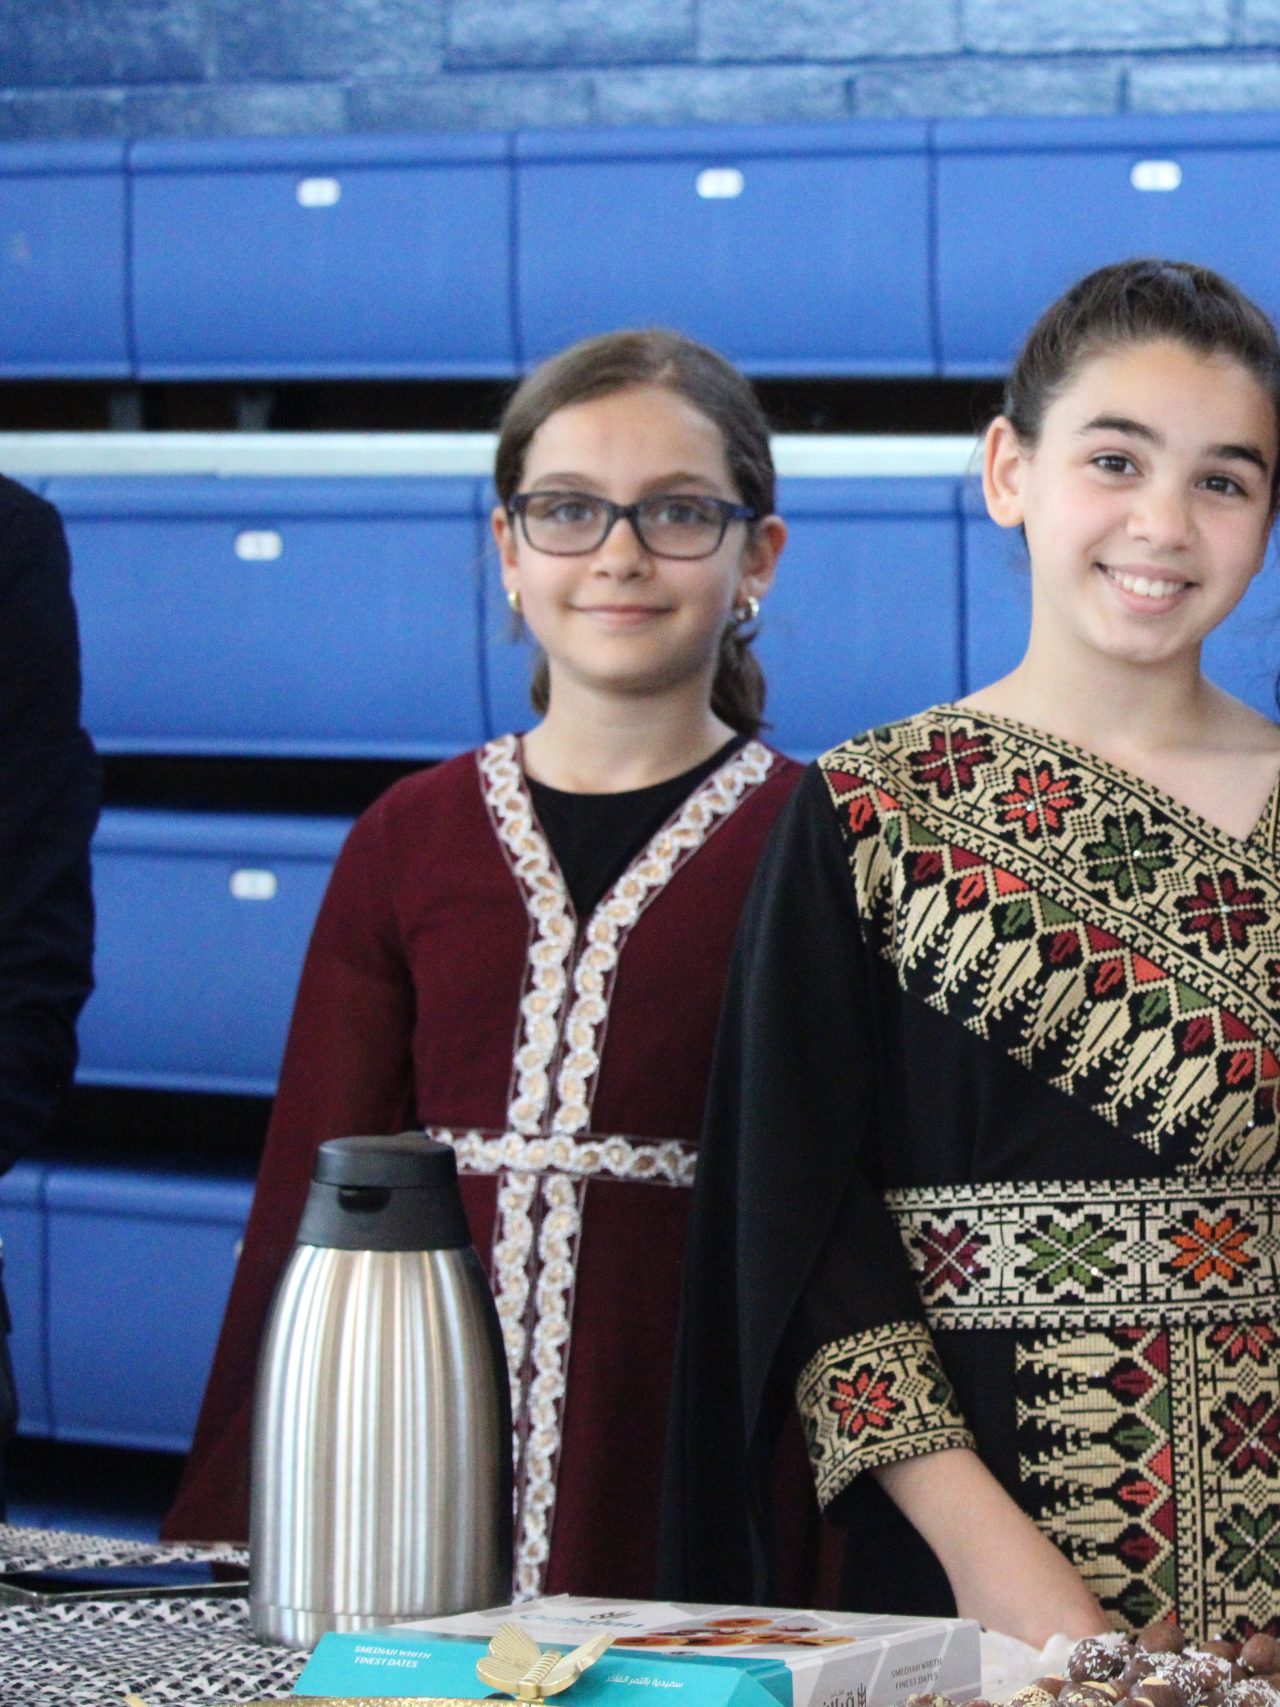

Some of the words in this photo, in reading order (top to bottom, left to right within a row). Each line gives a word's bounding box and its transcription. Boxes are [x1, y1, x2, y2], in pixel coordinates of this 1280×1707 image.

[354, 1656, 388, 1666] FINEST
[387, 1659, 418, 1668] DATES
[895, 1677, 916, 1690] FINEST
[918, 1672, 938, 1685] DATES
